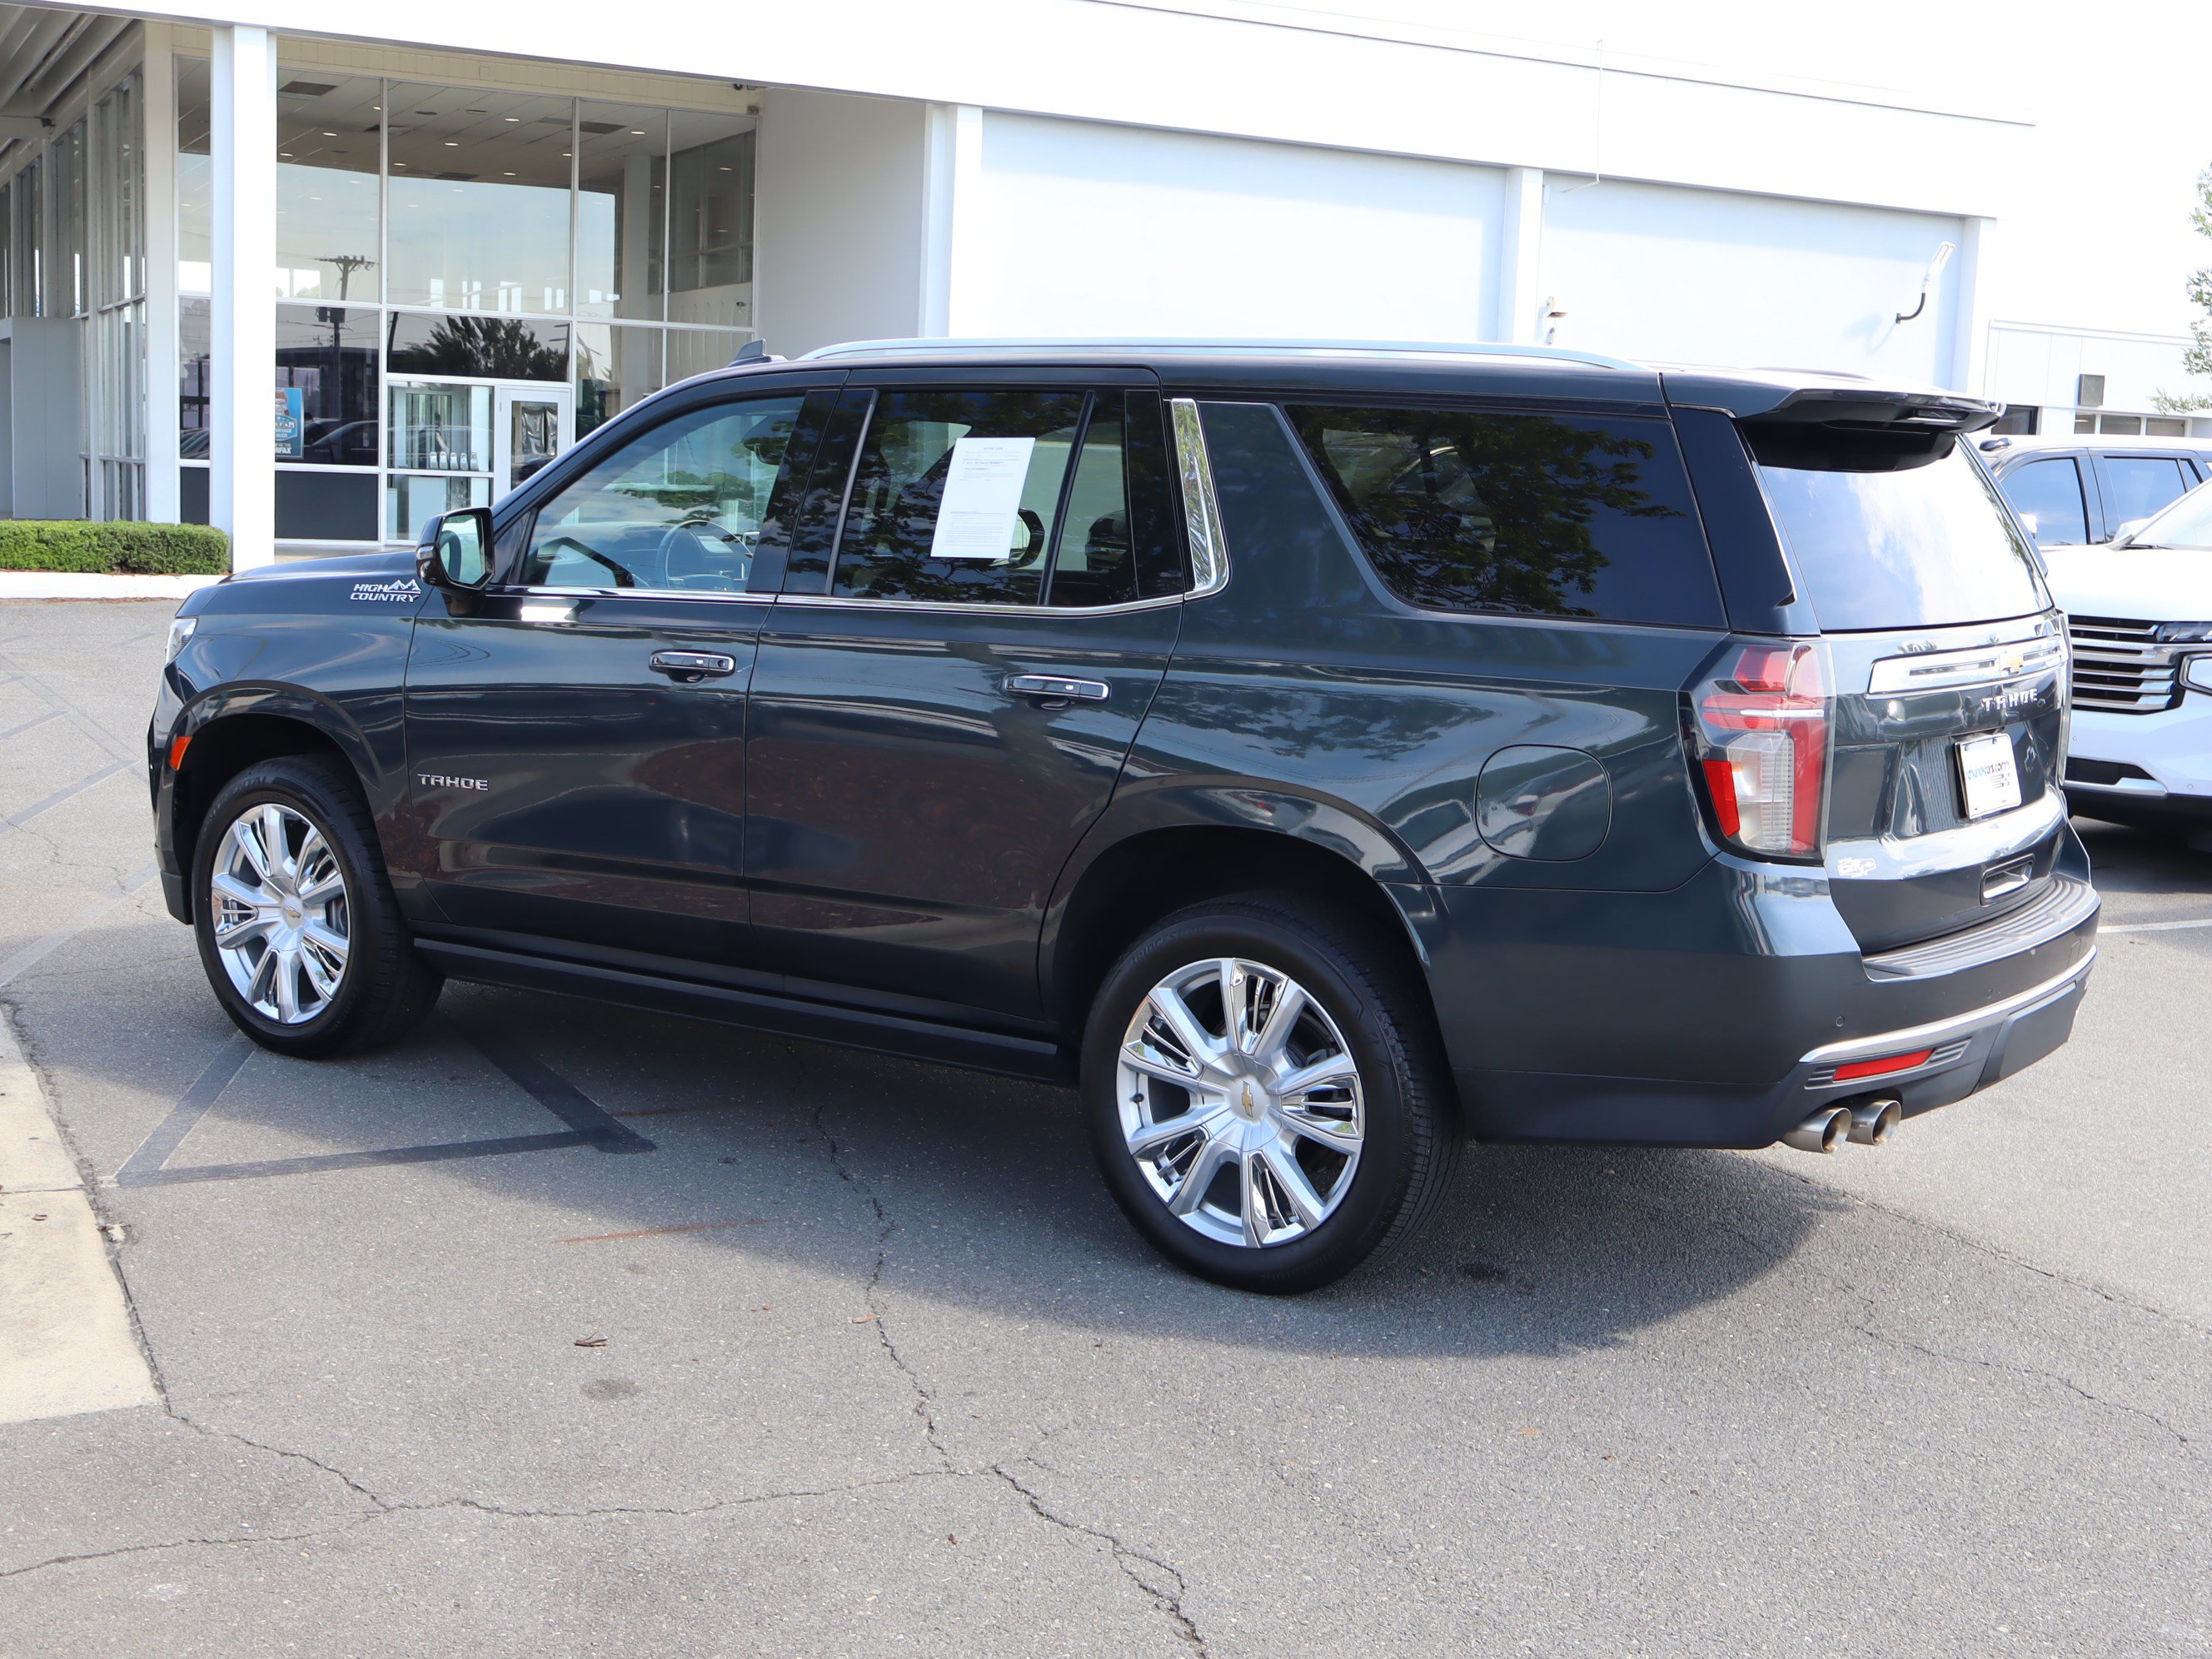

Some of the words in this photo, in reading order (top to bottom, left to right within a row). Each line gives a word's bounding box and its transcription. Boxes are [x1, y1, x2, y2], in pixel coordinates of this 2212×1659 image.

[353, 584, 388, 592] HIGH
[350, 592, 420, 603] COUNTRY
[1981, 688, 2039, 712] TAHOE
[416, 773, 489, 791] TAHOE
